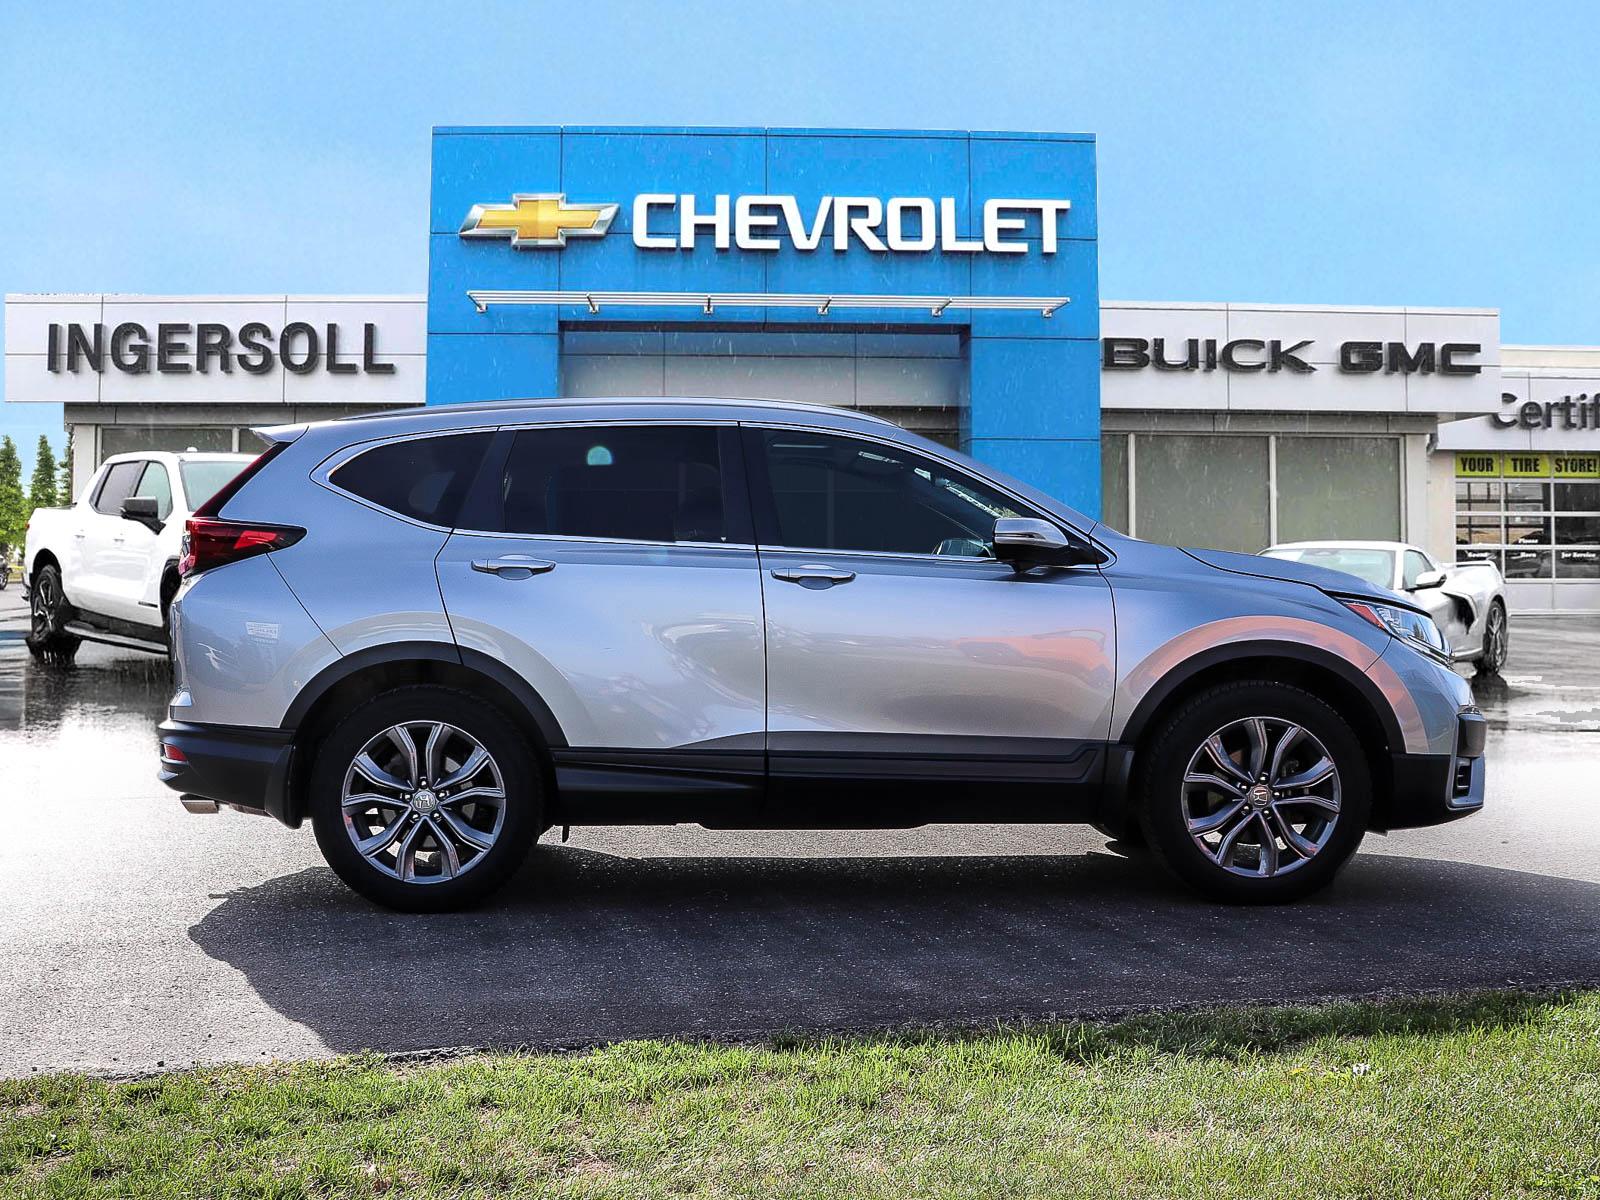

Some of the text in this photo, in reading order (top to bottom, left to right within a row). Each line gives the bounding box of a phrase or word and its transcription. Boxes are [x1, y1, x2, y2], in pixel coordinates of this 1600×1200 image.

[632, 193, 1072, 254] CHEVROLET
[48, 322, 396, 376] INGERSOLL
[1104, 338, 1482, 374] BUICK GMC
[1461, 458, 1597, 473] YOUR TIRE STORE!
